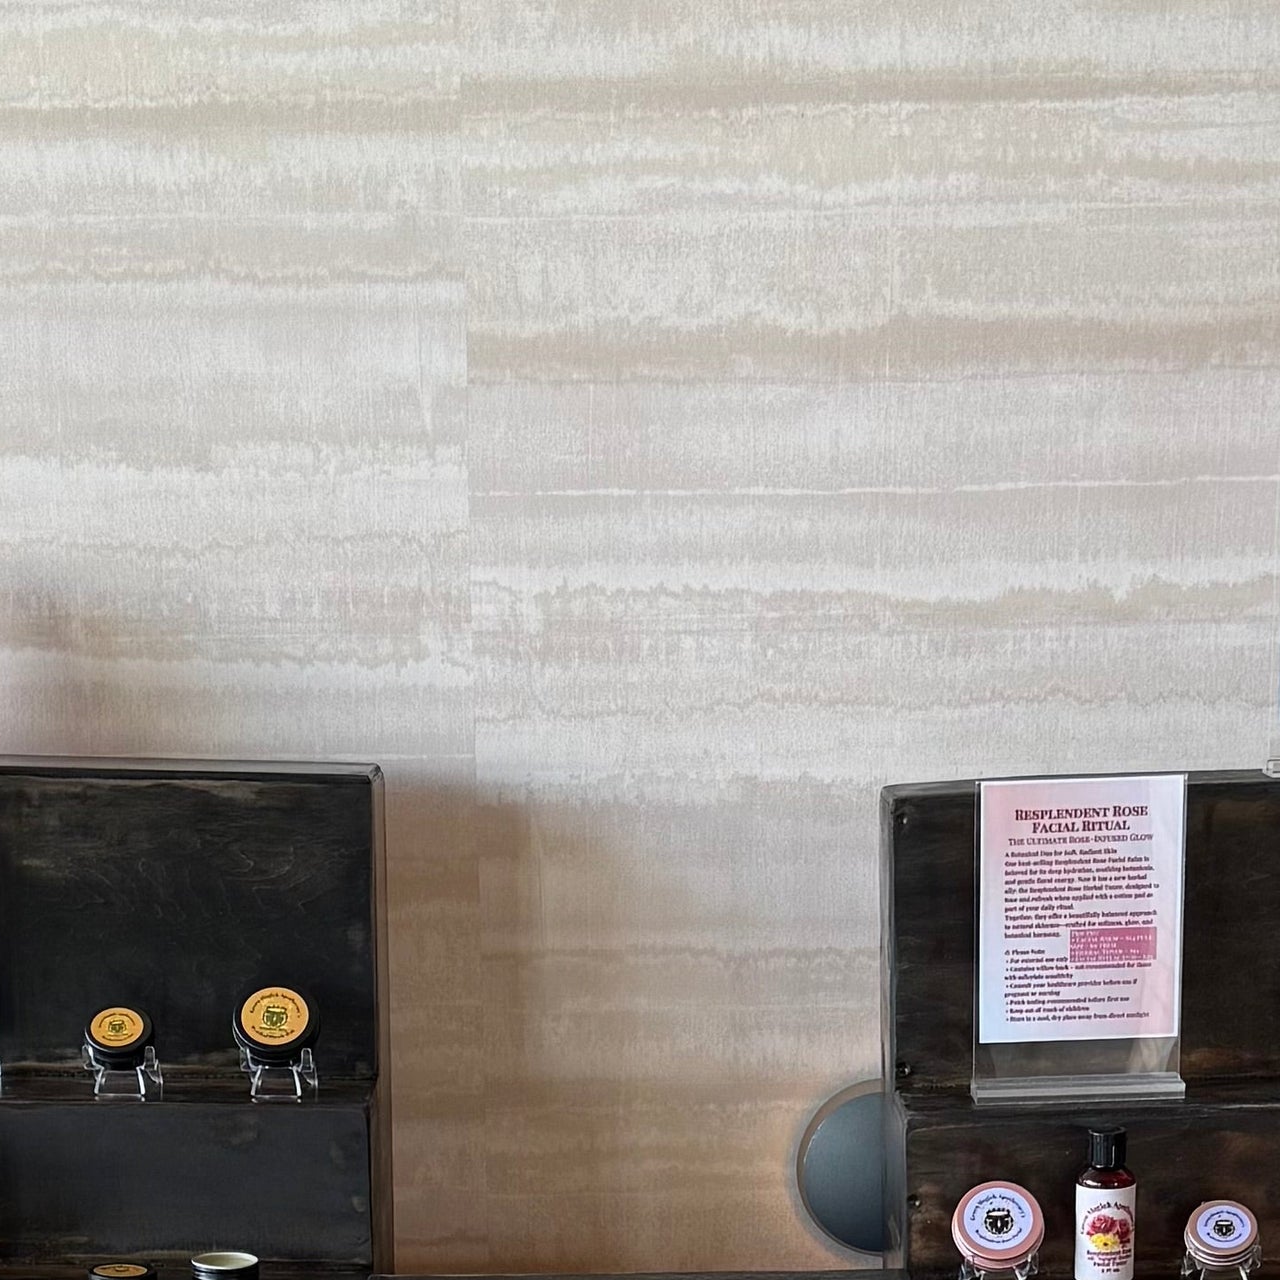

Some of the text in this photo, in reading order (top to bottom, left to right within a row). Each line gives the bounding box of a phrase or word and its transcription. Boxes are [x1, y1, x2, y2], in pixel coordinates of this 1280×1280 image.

[1015, 806, 1149, 821] RESPLENDENT ROSE
[1032, 820, 1131, 834] FACIAL RITUAL
